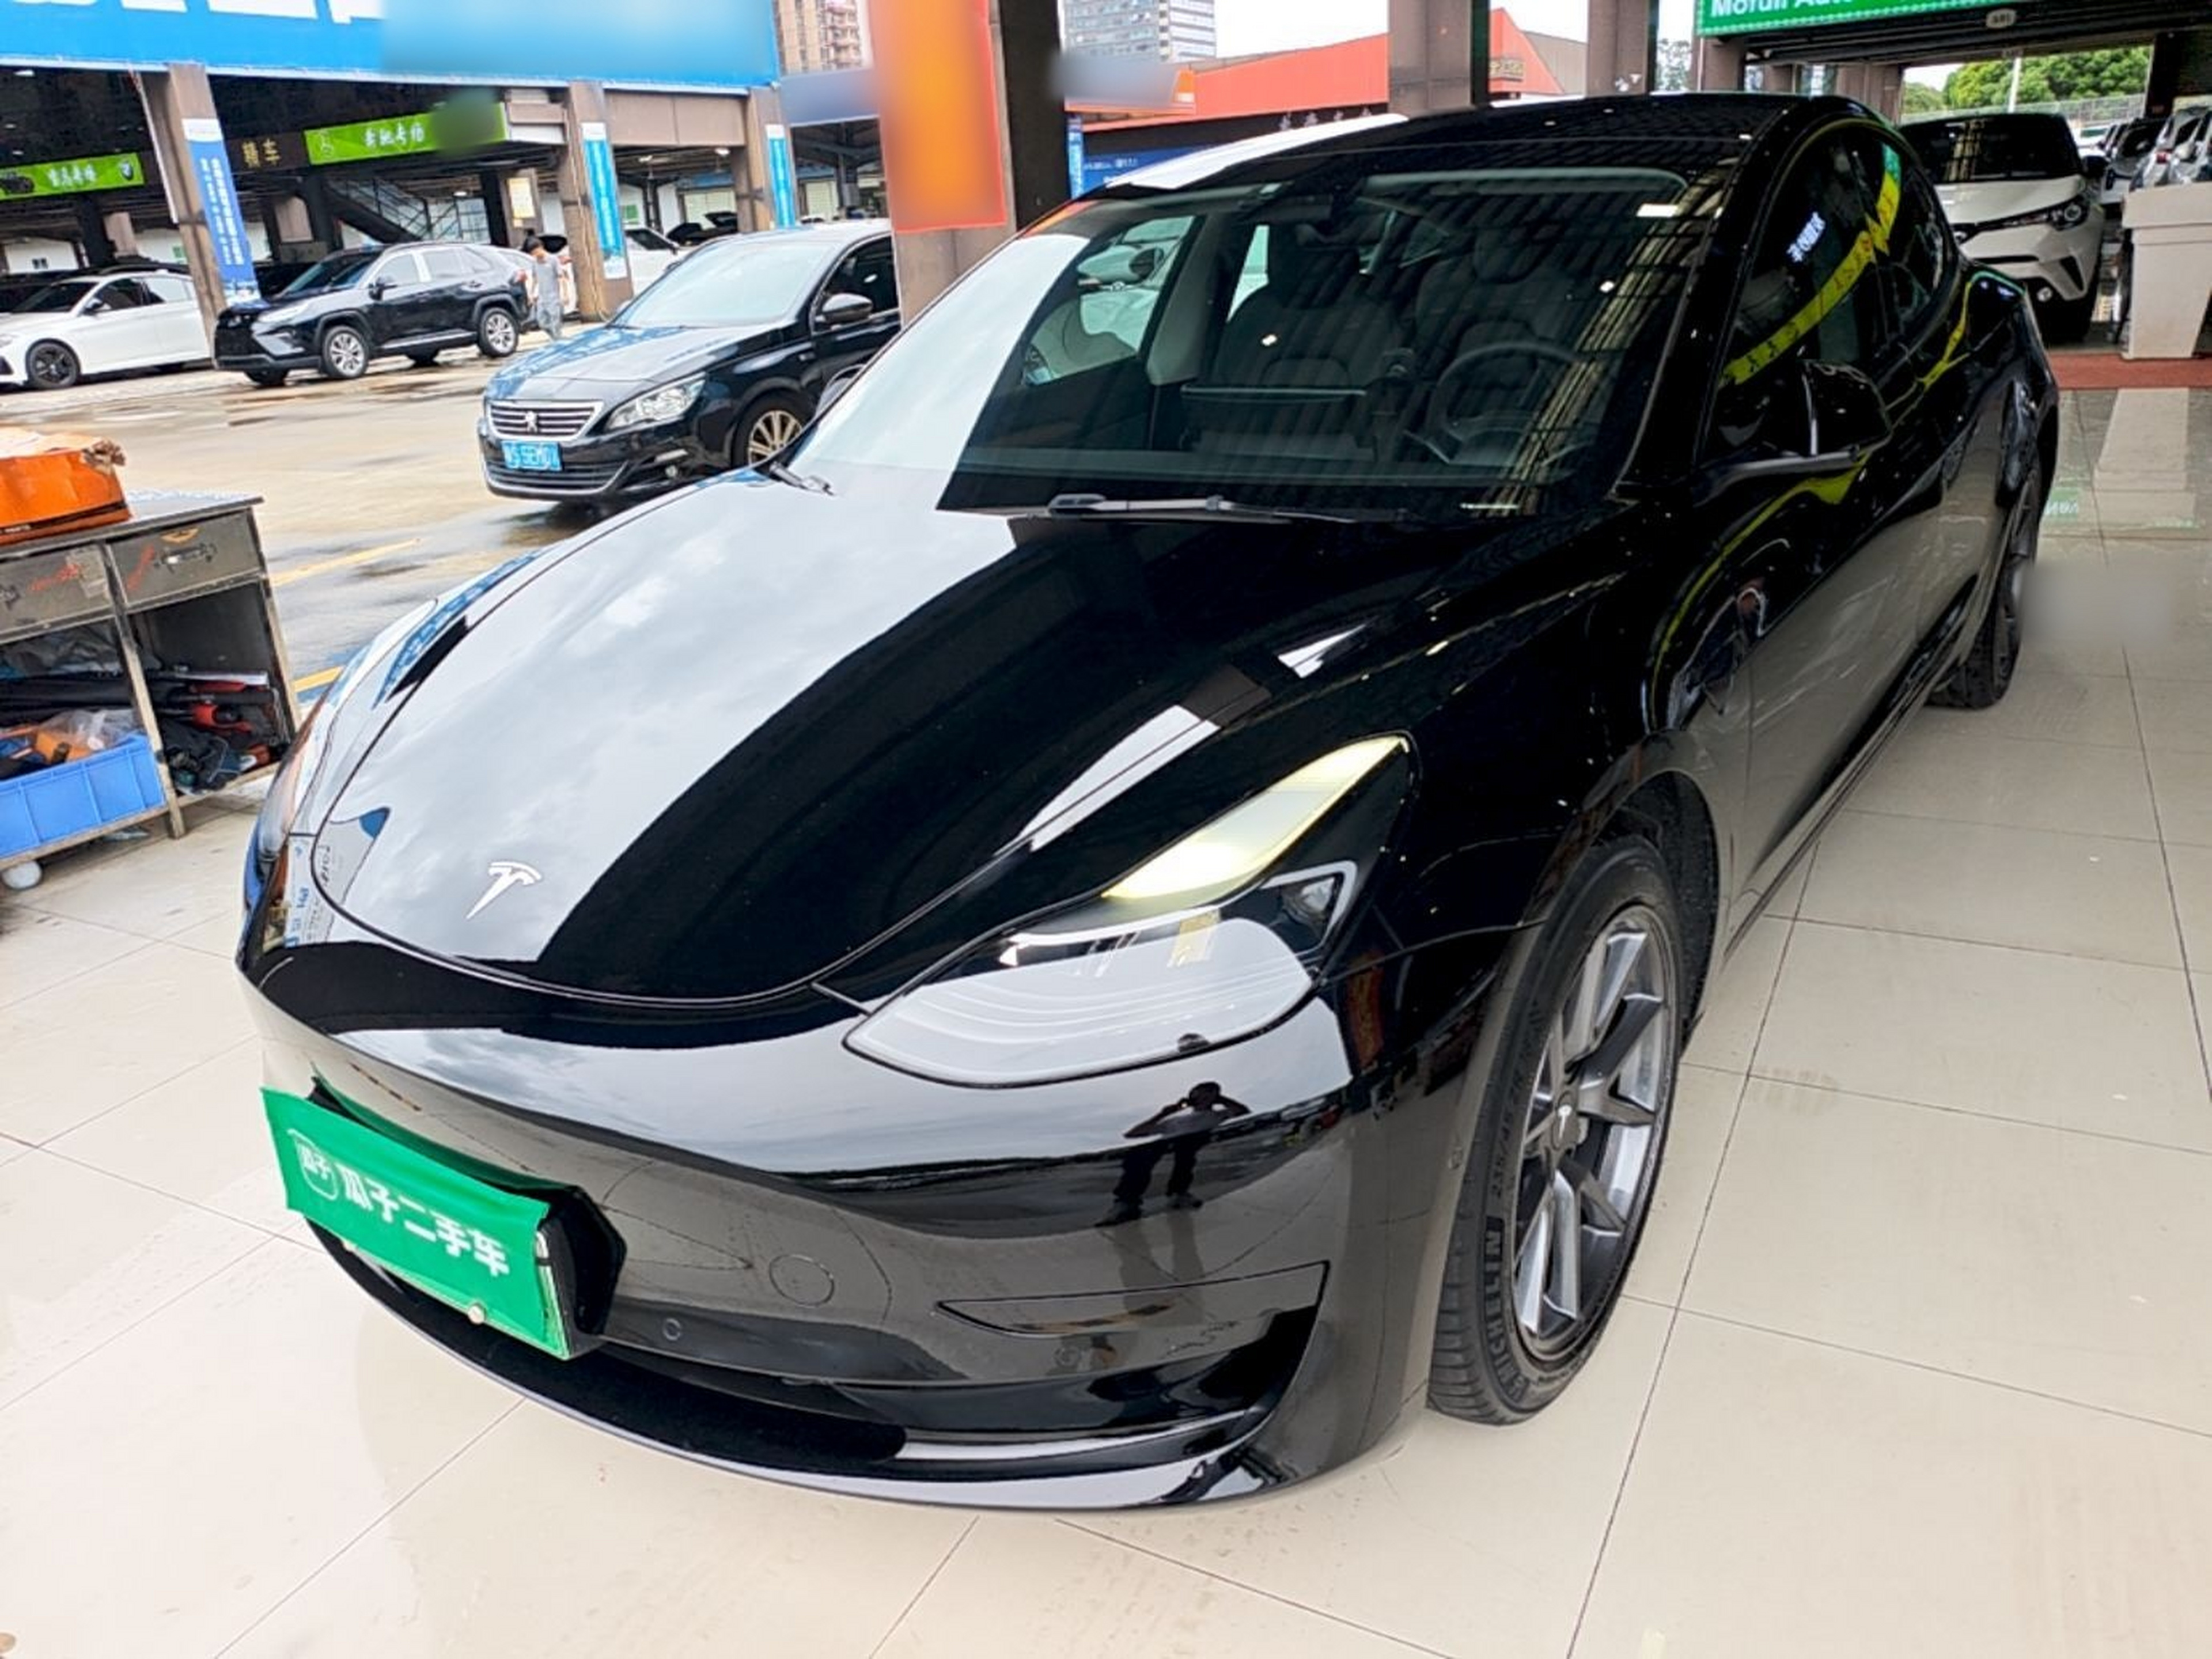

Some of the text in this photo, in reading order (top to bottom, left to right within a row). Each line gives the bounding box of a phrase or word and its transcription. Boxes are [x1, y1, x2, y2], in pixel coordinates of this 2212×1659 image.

[335, 1162, 510, 1277] 瓜子二手车
[1485, 1229, 1517, 1384] MICHELIN
